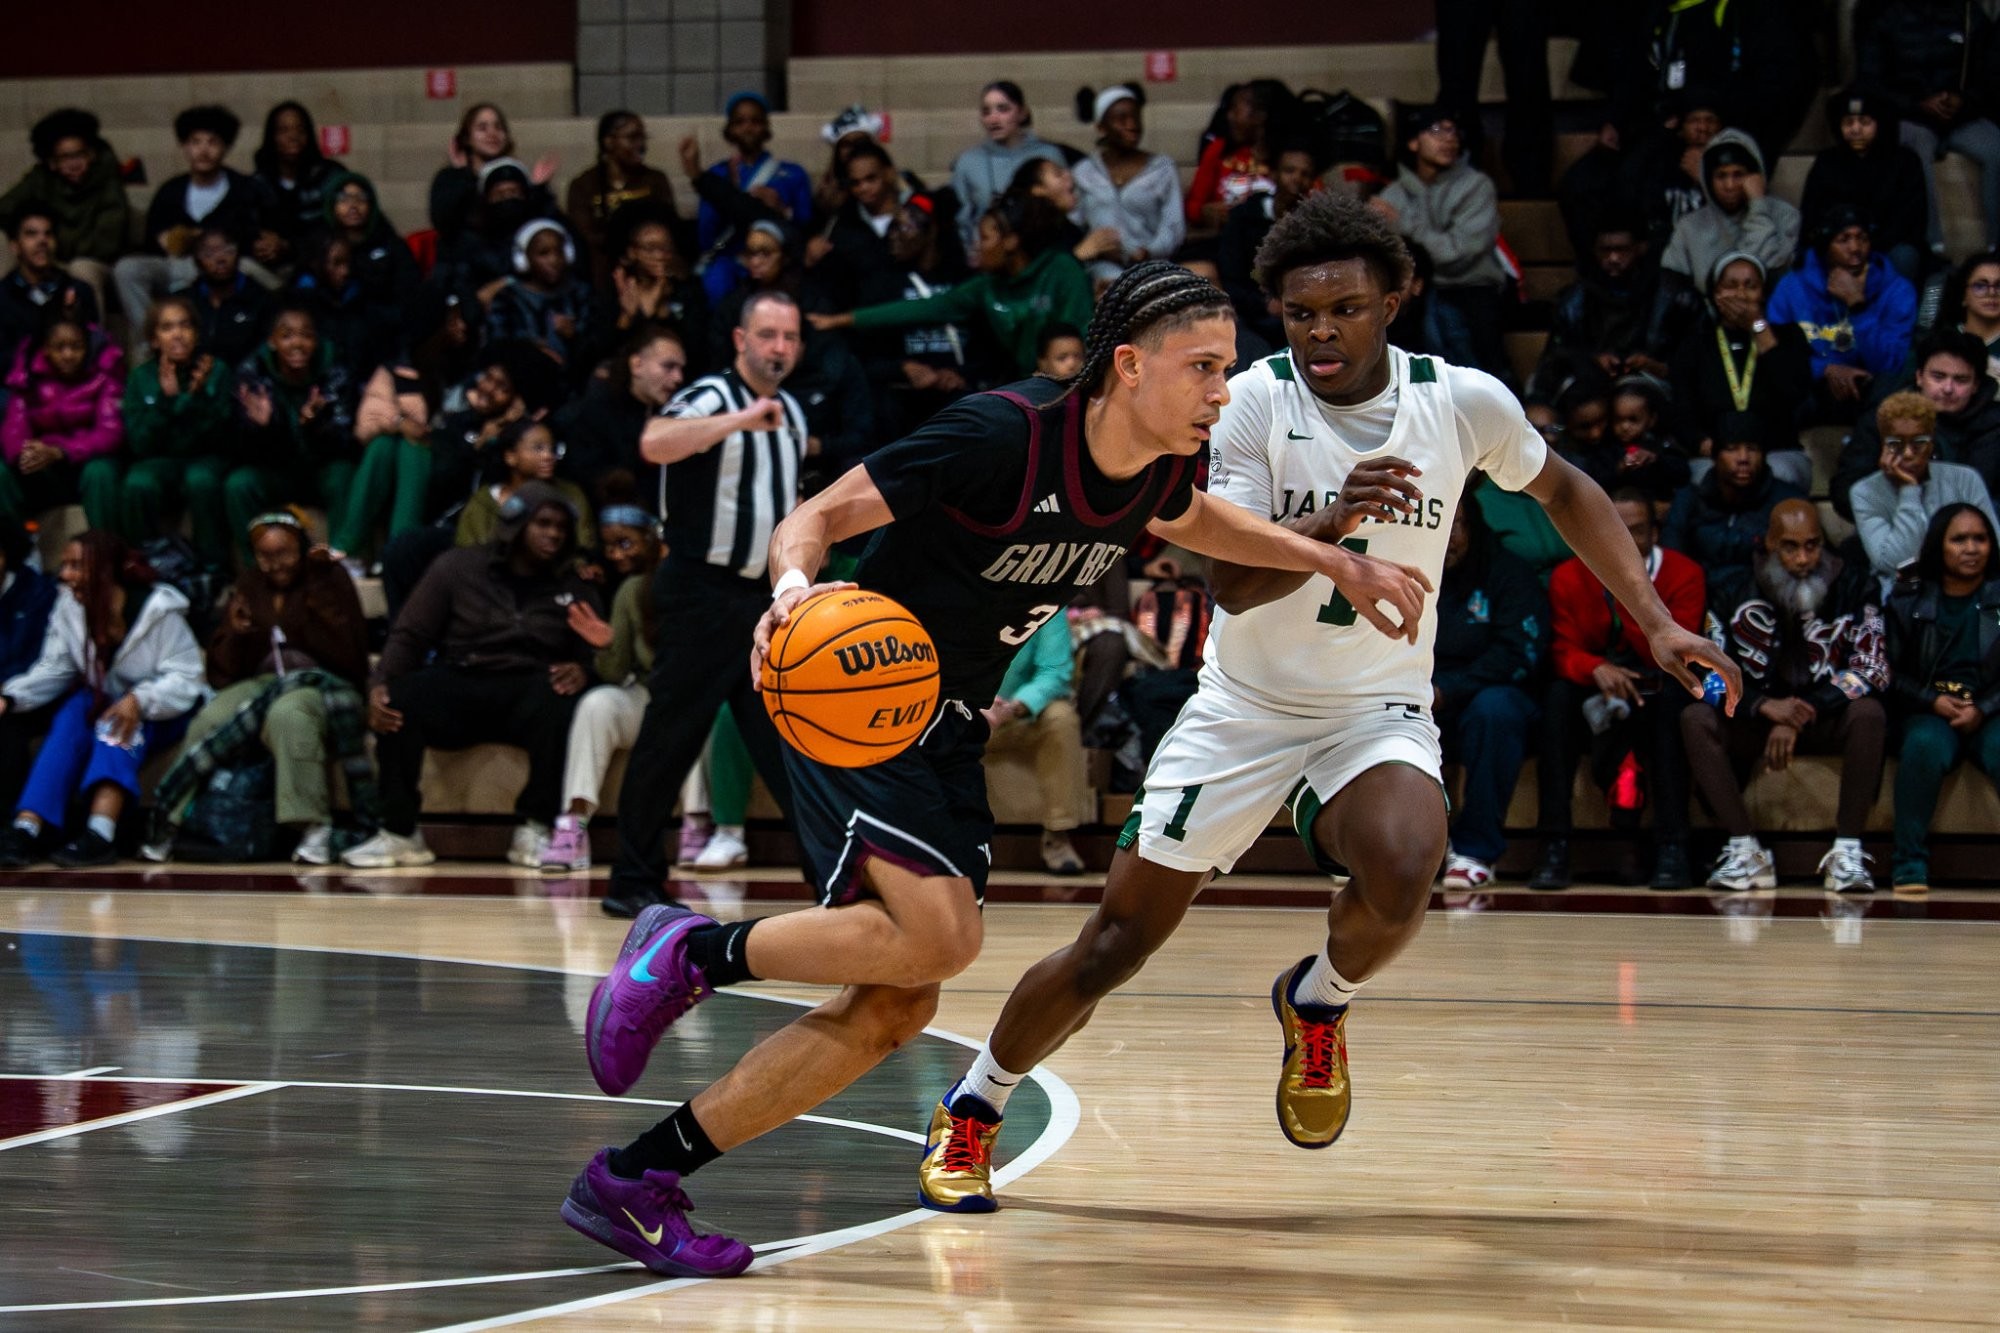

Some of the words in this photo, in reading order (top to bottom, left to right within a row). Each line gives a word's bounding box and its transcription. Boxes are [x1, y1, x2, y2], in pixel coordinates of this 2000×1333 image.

[1272, 489, 1444, 530] JAARS
[980, 542, 1090, 583] GRAY
[1073, 542, 1129, 586] BEE
[999, 604, 1059, 646] 3
[833, 634, 937, 676] Wilson
[867, 699, 927, 728] EVO
[1162, 783, 1204, 843] 1
